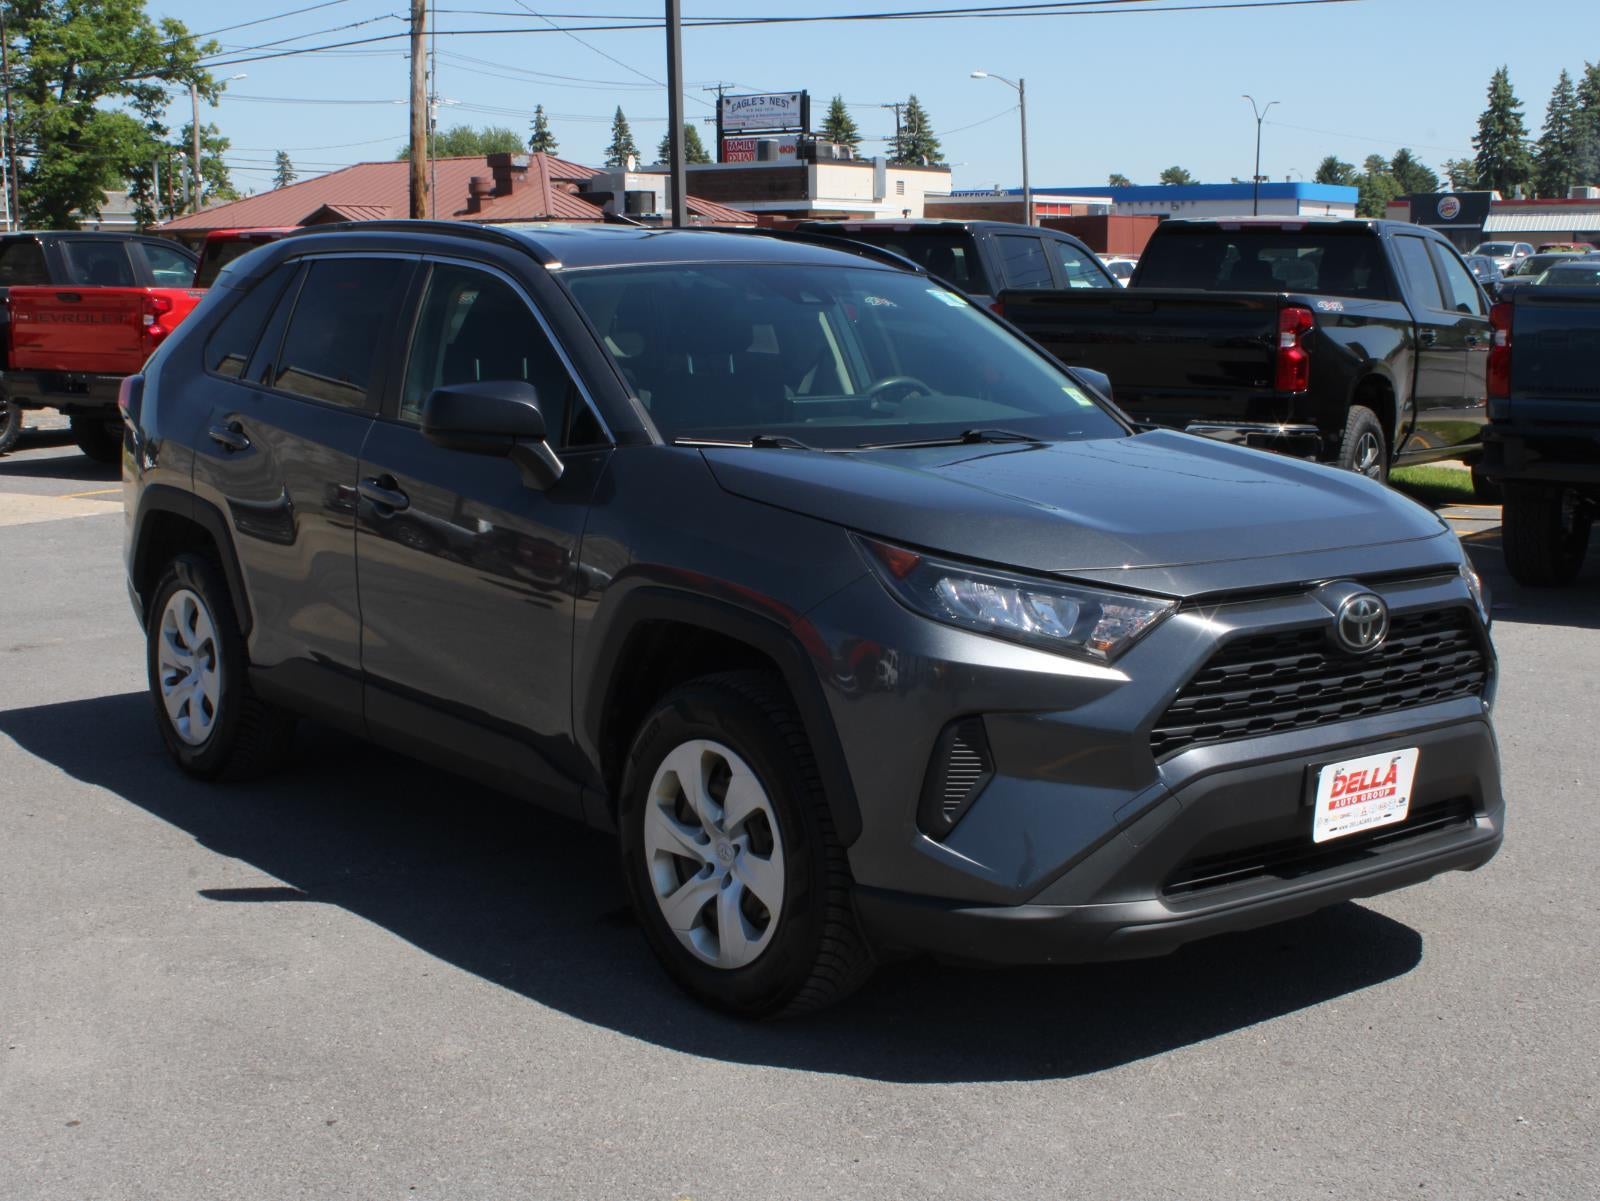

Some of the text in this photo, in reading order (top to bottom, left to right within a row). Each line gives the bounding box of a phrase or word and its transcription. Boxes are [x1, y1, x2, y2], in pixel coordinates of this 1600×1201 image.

[731, 96, 790, 112] EAGLE'S NEST
[727, 140, 754, 151] FAMILY
[1330, 763, 1397, 799] DELLA
[1334, 790, 1391, 809] AUTO GROUP
